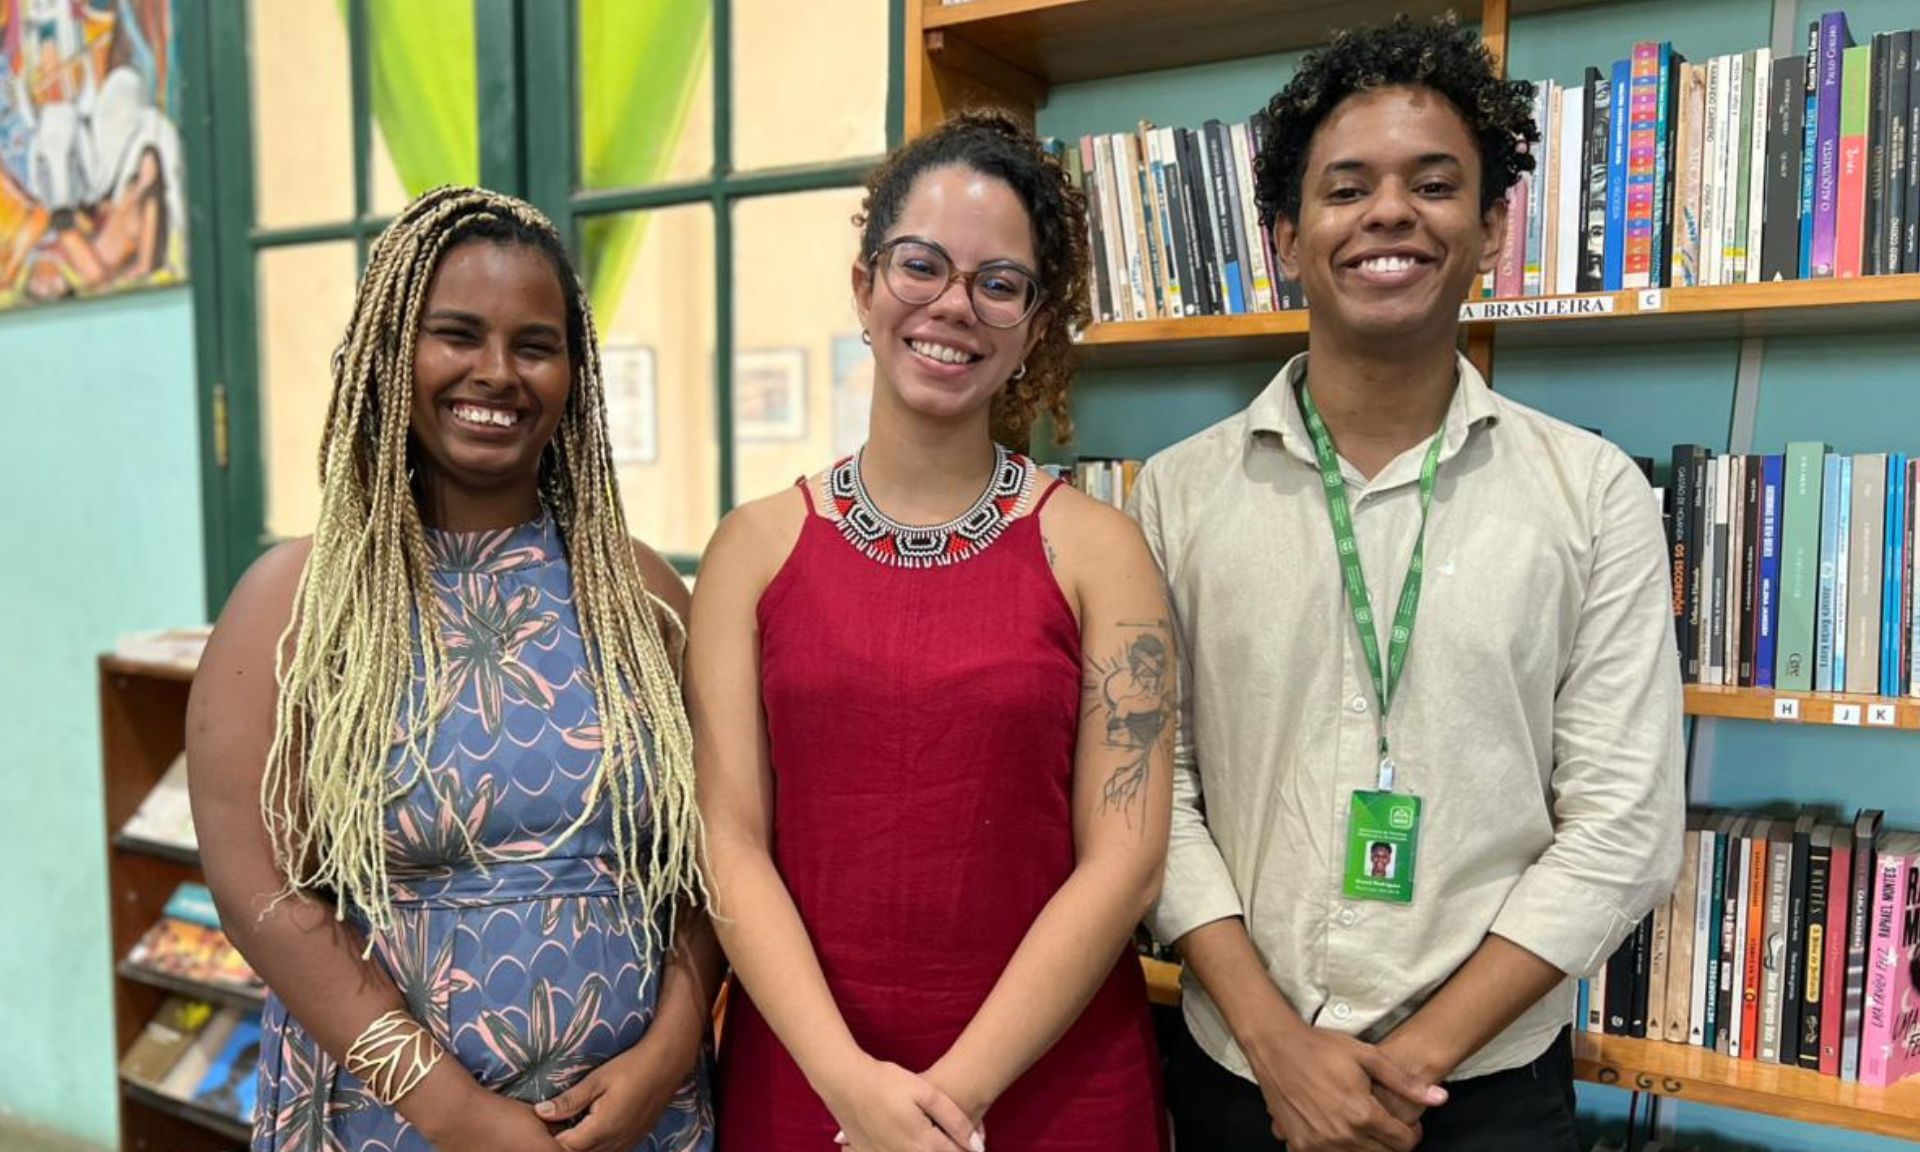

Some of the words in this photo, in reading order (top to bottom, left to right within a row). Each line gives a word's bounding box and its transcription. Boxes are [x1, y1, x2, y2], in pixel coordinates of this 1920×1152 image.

[1825, 25, 1837, 58] COELHO
[1823, 59, 1835, 85] PAULO
[1821, 138, 1833, 201] ALQUIMISTA
[1484, 298, 1605, 318] BRASILEIRA
[1645, 295, 1655, 306] C
[1674, 544, 1685, 557] OS
[1673, 560, 1685, 617] ESCORPIÕES
[1782, 703, 1792, 714] H
[1843, 710, 1849, 720] J
[1876, 709, 1886, 720] K
[1881, 867, 1896, 902] MONTES
[1856, 890, 1864, 914] CARLA
[1878, 905, 1893, 938] RAPHAEL
[1707, 959, 1718, 1024] METAMORFOSES
